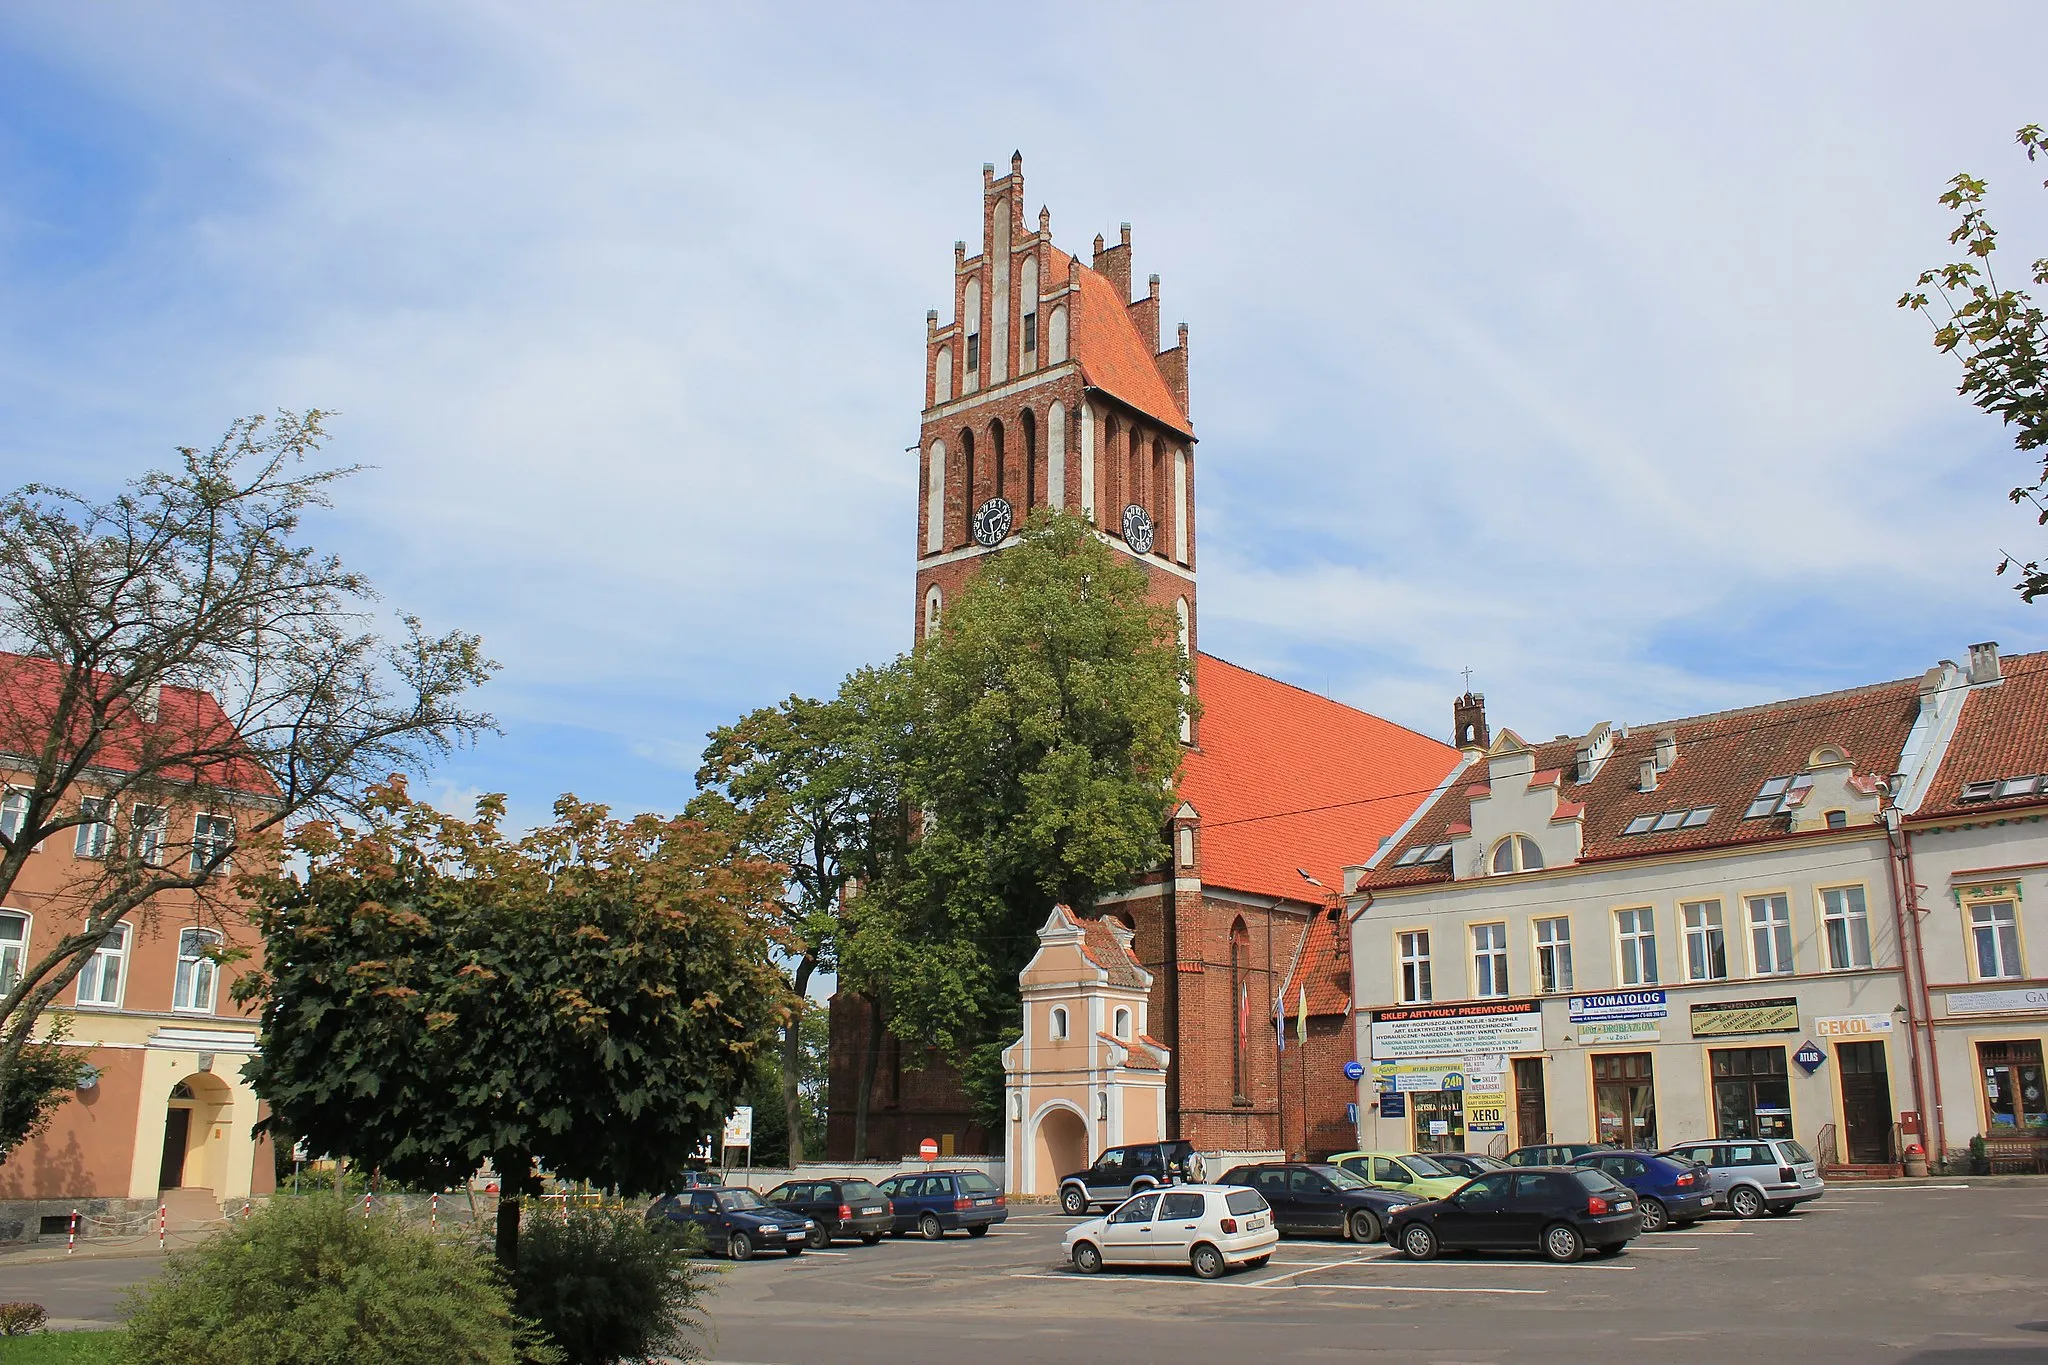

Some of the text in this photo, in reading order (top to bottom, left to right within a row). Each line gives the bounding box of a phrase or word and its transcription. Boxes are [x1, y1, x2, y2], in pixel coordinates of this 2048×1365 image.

[1586, 992, 1659, 1006] STOMATOLOG
[2026, 992, 2048, 1002] GA
[1381, 1004, 1530, 1020] SKLEP ARTYKUŁY PRZEMYSŁOWE
[1450, 1022, 1512, 1030] ELEKTROTECHNICZNE
[1818, 1019, 1871, 1034] CEKOL
[1800, 1052, 1818, 1062] ATLAS
[1444, 1075, 1462, 1088] 24h
[1472, 1109, 1499, 1121] XERO
